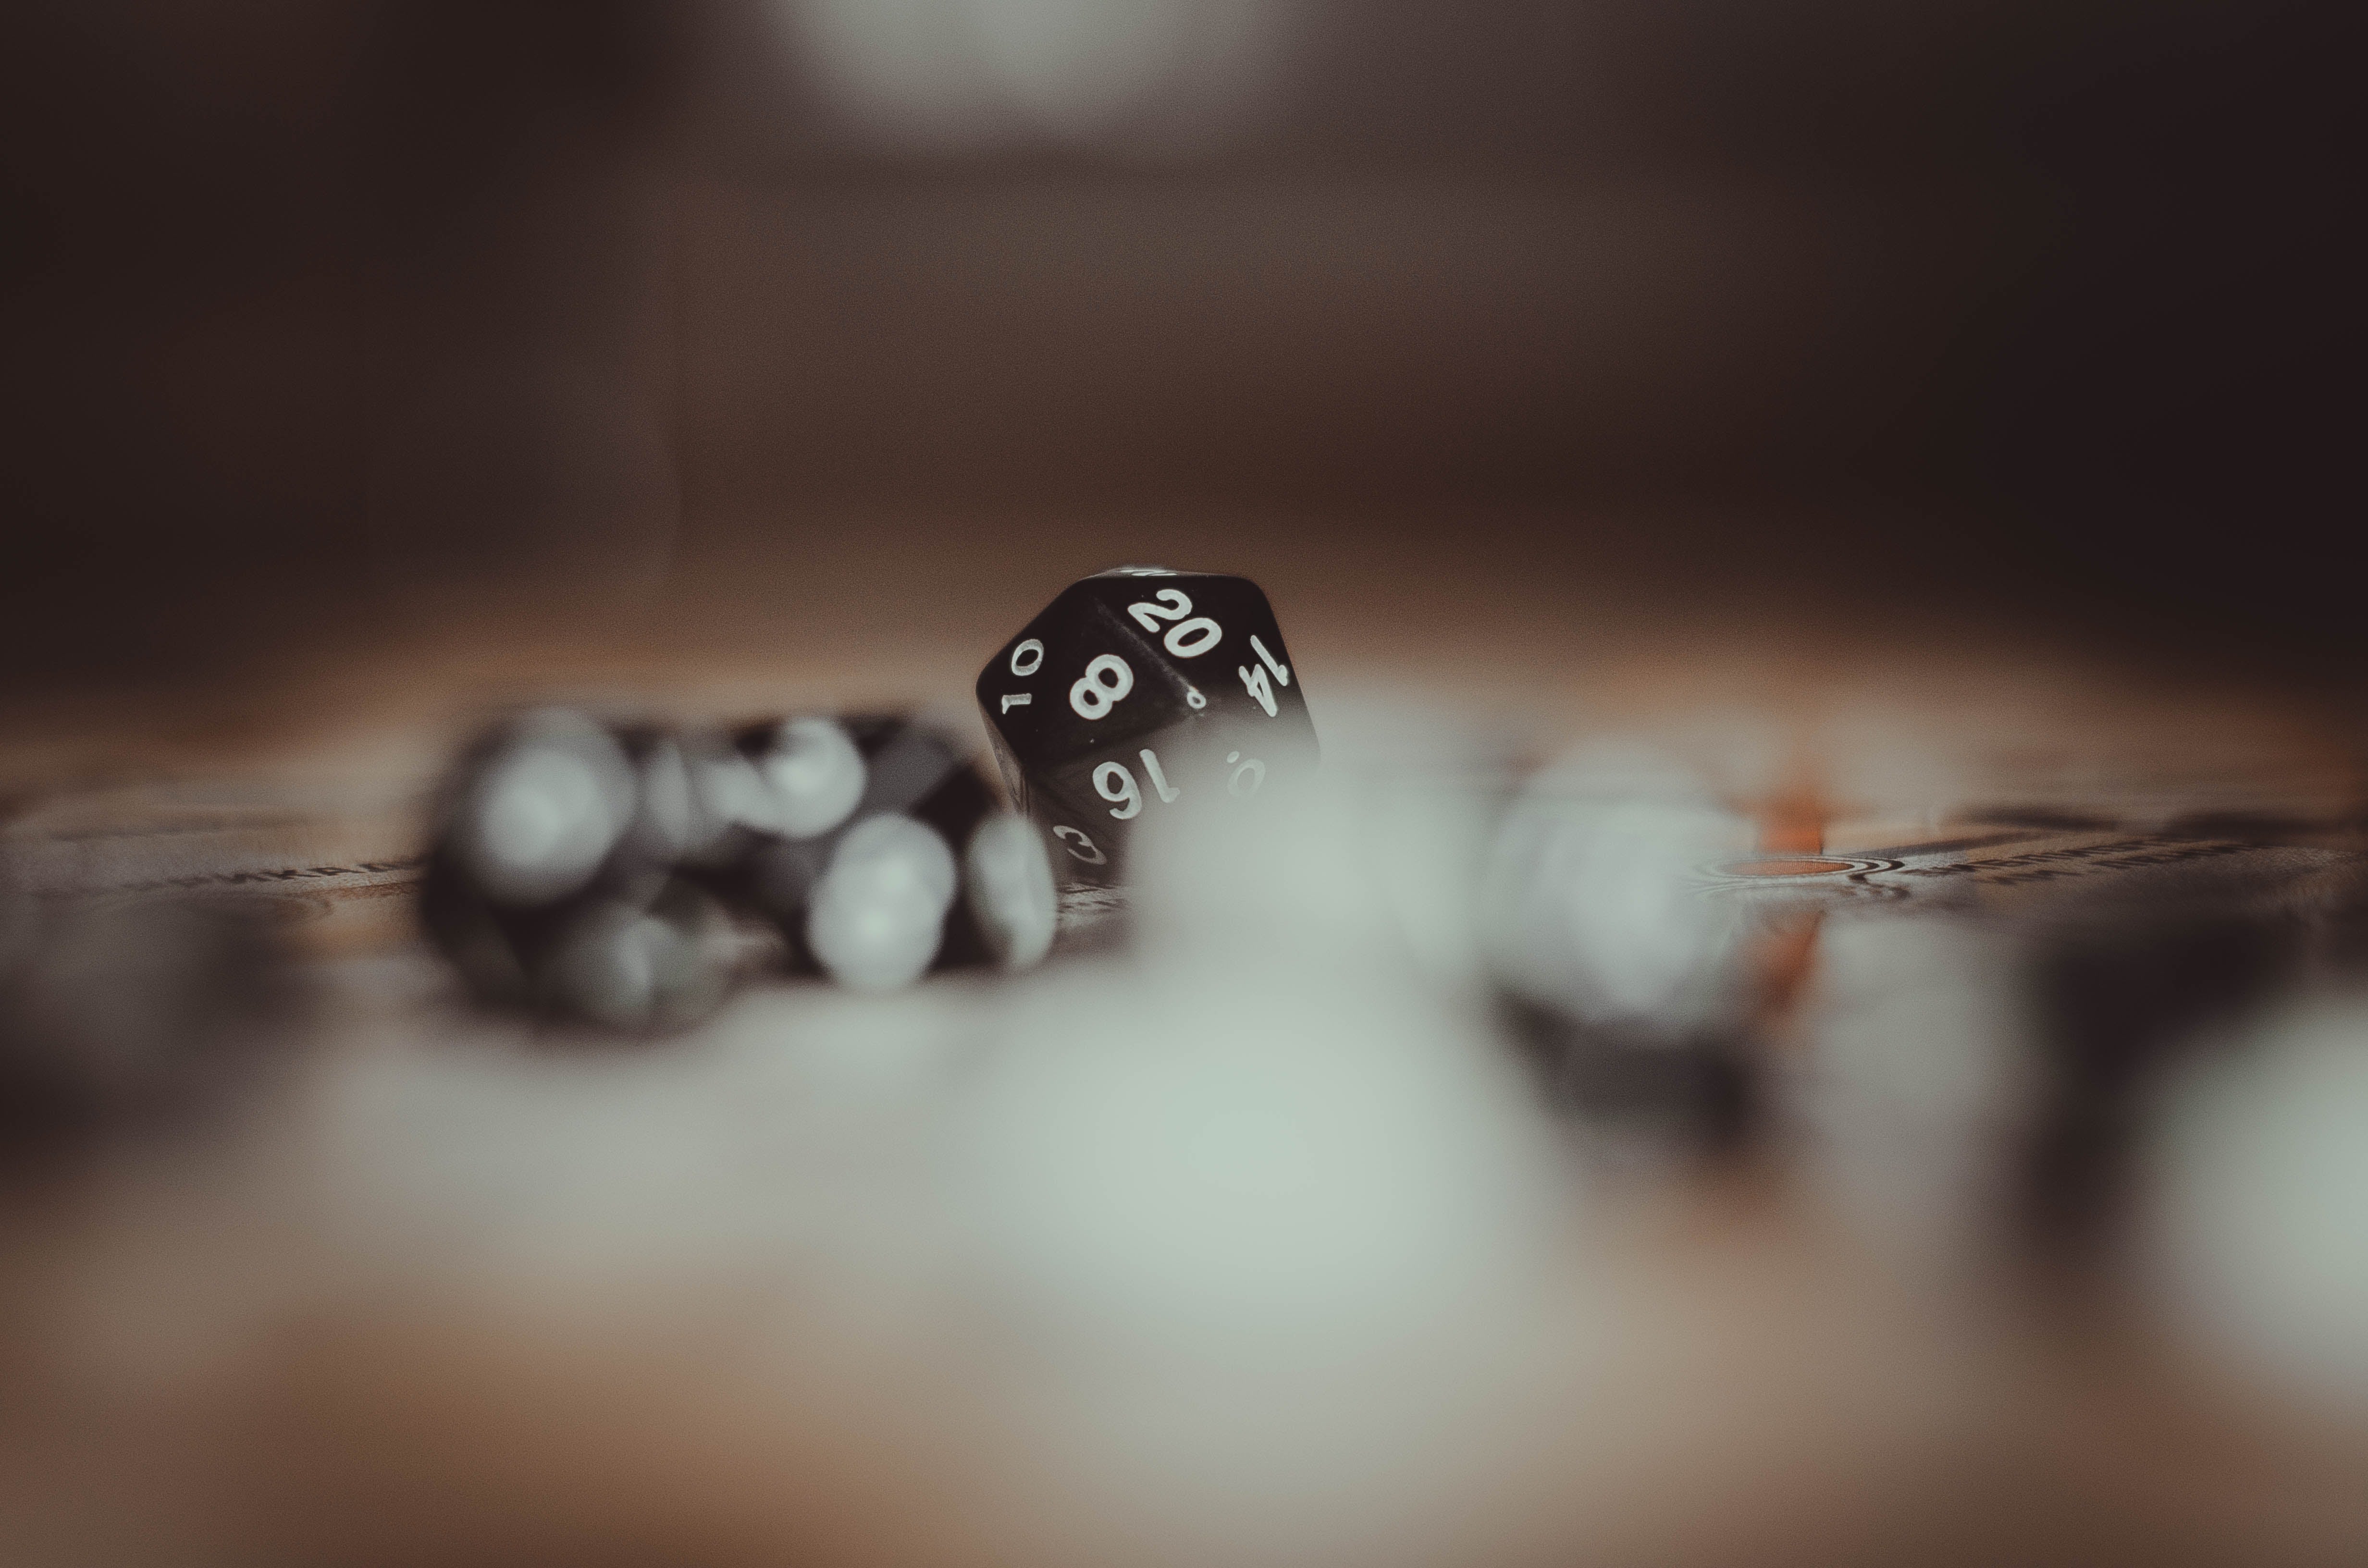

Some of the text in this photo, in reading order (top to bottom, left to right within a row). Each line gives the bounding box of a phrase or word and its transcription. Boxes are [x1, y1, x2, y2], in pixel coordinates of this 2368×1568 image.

[1128, 589, 1222, 657] 20
[1001, 639, 1043, 714] 10
[1070, 654, 1133, 720] 8
[1239, 636, 1288, 717] 14
[1092, 749, 1180, 820] 16
[1053, 825, 1106, 864] 3
